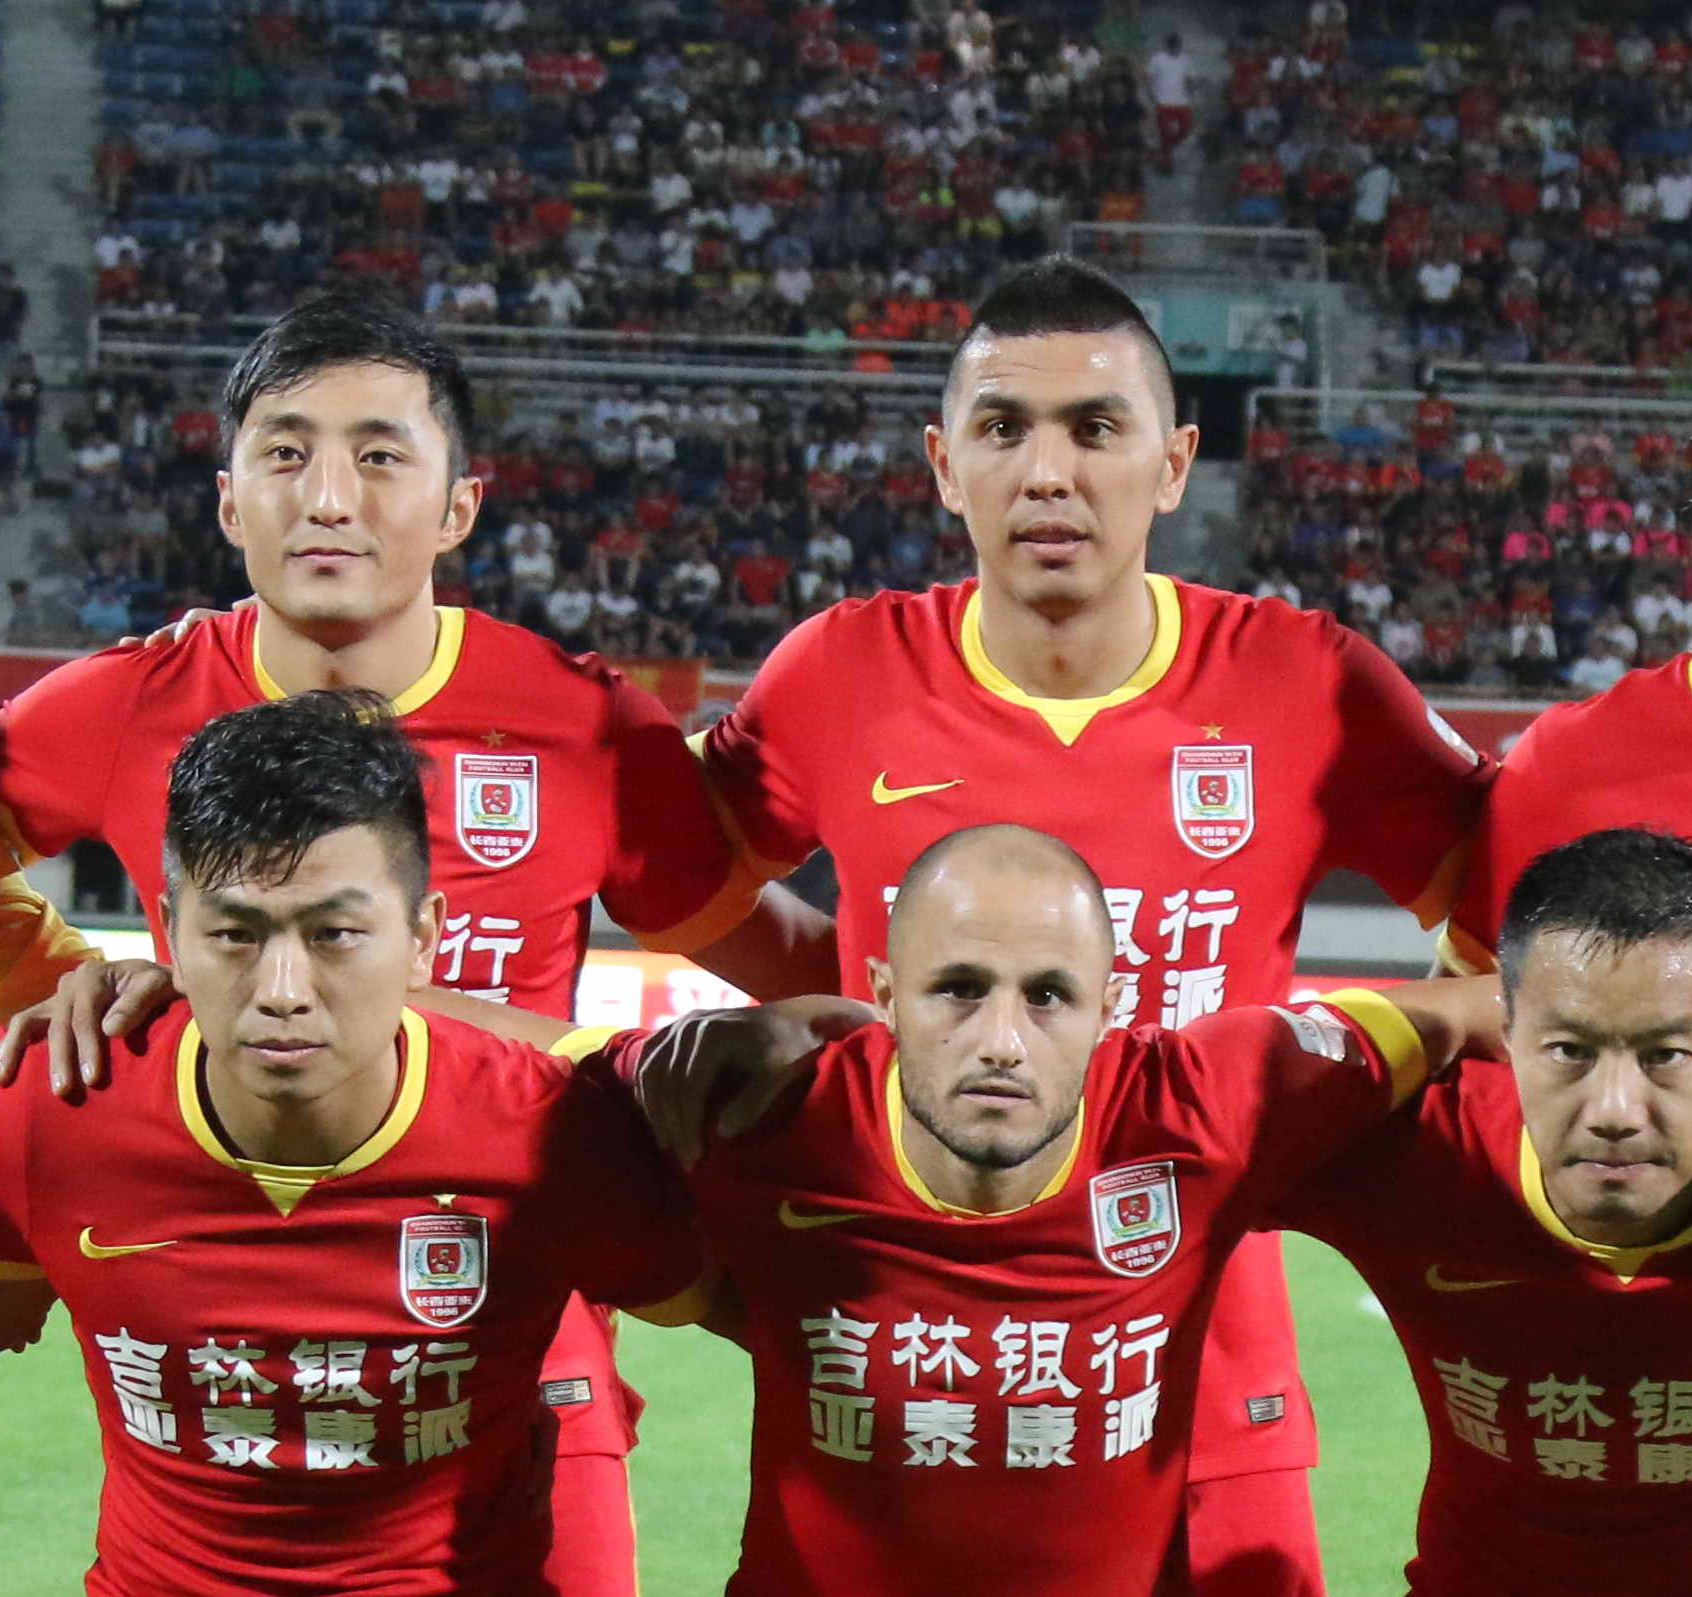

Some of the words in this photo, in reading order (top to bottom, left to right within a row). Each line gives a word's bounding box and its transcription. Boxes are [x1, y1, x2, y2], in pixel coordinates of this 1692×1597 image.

[94, 1326, 478, 1407] 吉林银行
[801, 1307, 1171, 1398] 吉林银行
[116, 1400, 473, 1471] 亚泰康派
[809, 1379, 1162, 1469] 亚泰康派
